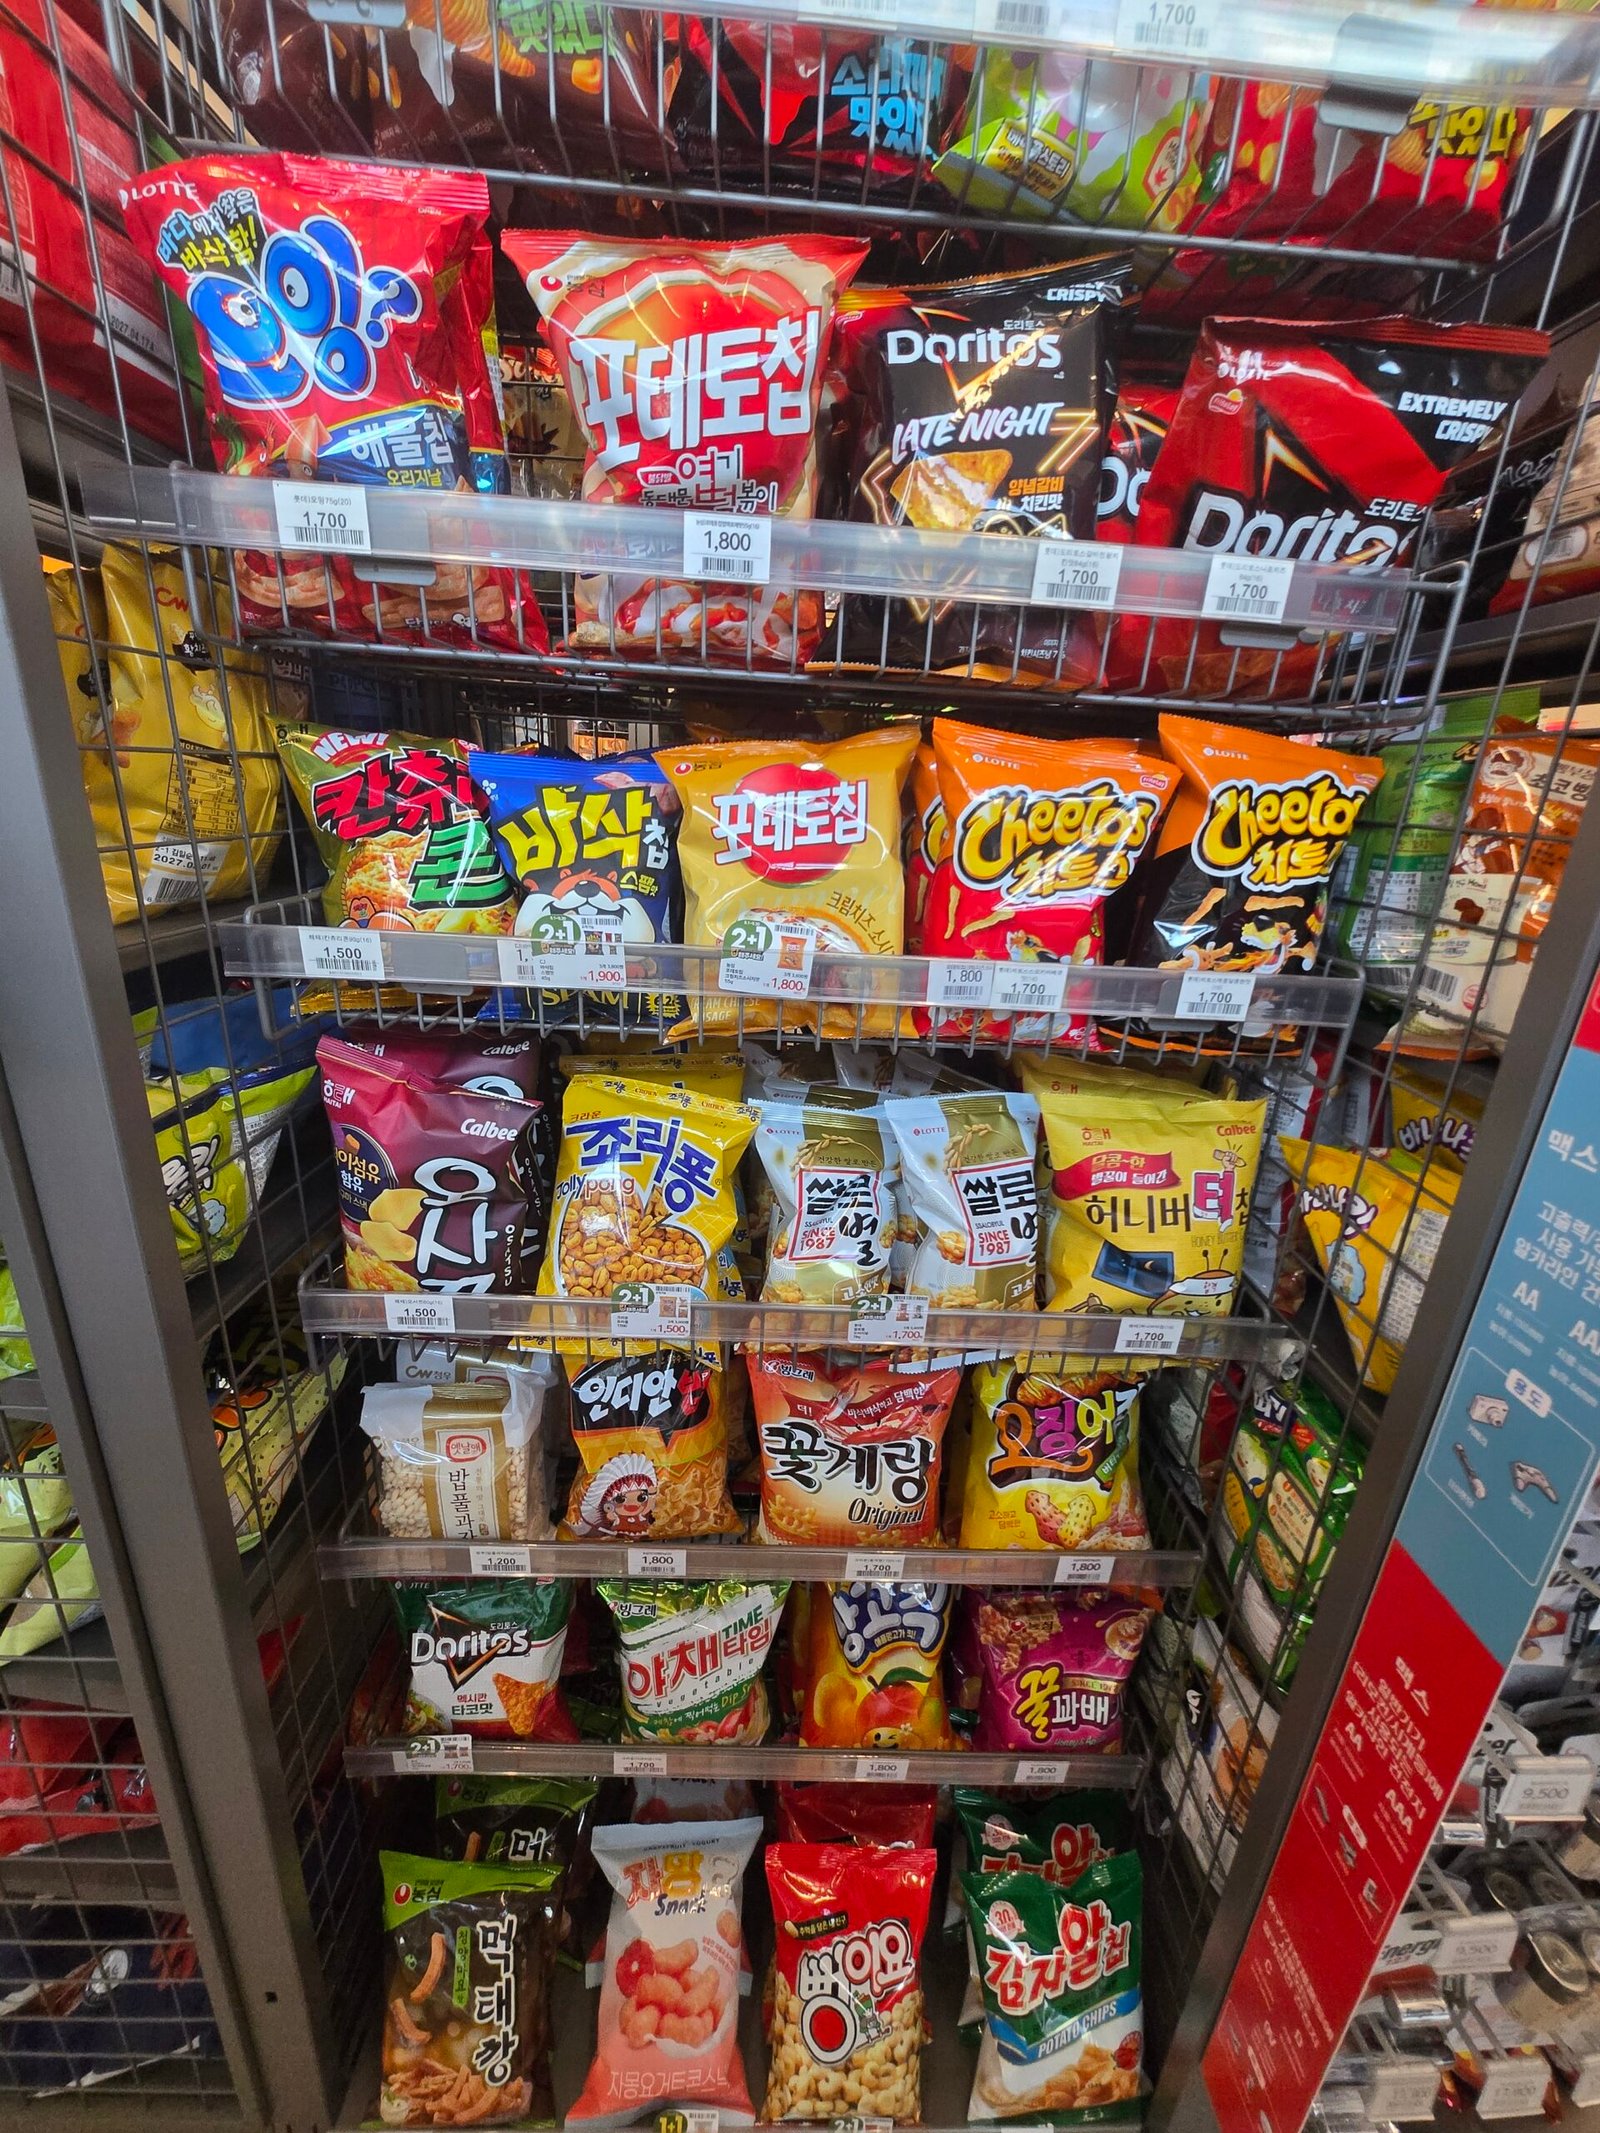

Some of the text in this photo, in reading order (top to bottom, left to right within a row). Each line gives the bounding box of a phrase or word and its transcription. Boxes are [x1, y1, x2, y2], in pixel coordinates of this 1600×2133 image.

[1149, 3, 1196, 26] 1,700
[131, 181, 198, 200] LOTTE
[181, 215, 257, 270] 바삭함!
[1046, 286, 1105, 302] CRISPY
[1003, 319, 1045, 331] 도리토스
[887, 328, 1062, 368] Doritos
[569, 306, 821, 469] 포테토칩
[1398, 392, 1507, 421] EXTREMELY
[347, 410, 455, 468] 해물칩
[891, 402, 1064, 465] LATE NIGHT
[1008, 477, 1064, 496] 양념갈비
[1020, 495, 1063, 513] 치킨맛
[303, 511, 347, 528] 1,700
[704, 530, 751, 552] 1,800
[1058, 569, 1099, 585] 1,700
[1229, 583, 1268, 600] 1,700
[314, 732, 389, 761] NEW!
[1214, 748, 1249, 761] LOTTE
[984, 756, 1020, 769] LOTTE
[711, 780, 868, 865] 포테토칩
[1203, 778, 1365, 866] Cheeto
[962, 785, 1154, 880] Cheetos
[412, 820, 509, 902] 콘
[1249, 838, 1345, 885] 치토
[620, 871, 658, 896] 스팸맛
[826, 891, 876, 932] 크림치즈
[539, 921, 574, 944] 2+1
[731, 926, 767, 951] 2+1
[323, 947, 362, 959] 1,500
[588, 970, 620, 982] 1,900
[771, 978, 803, 991] 1,800
[946, 970, 982, 983] 1,800
[1011, 983, 1045, 994] 1,700
[1198, 991, 1233, 1003] 1,700
[482, 1041, 530, 1056] Calbee
[460, 1118, 518, 1141] Calbee
[922, 1127, 945, 1135] LOTTE
[1217, 1123, 1257, 1137] Calbee
[335, 1148, 381, 1184] 이섬유
[565, 1117, 719, 1213] 죠리퐁
[340, 1169, 364, 1193] 함유
[800, 1238, 836, 1250] 1987
[978, 1230, 1009, 1243] SINCE
[1191, 1235, 1215, 1247] HONEY
[1537, 1227, 1572, 1259] 사용
[504, 1225, 516, 1287] OSATSU
[979, 1242, 1011, 1256] 1987
[619, 1287, 649, 1306] 2+1
[858, 1297, 887, 1313] 2+1
[1513, 1281, 1540, 1312] AA
[404, 1308, 437, 1318] 1,500
[657, 1325, 686, 1333] 1,500
[893, 1331, 920, 1339] 1,700
[1134, 1332, 1164, 1341] 1,700
[780, 1362, 815, 1381] 빙그레
[797, 1404, 812, 1416] 더!
[894, 1386, 925, 1404] 담백한
[763, 1421, 934, 1503] 꽃게랑
[448, 1468, 477, 1539] 밥풀과자
[848, 1498, 926, 1530] Original
[488, 1557, 517, 1566] 1,200
[642, 1555, 674, 1565] 1,800
[1070, 1563, 1101, 1571] 1,800
[620, 1604, 656, 1617] 빙그레
[490, 1621, 518, 1630] 도리토스
[722, 1605, 763, 1639] TIME
[411, 1628, 529, 1663] Doritos
[627, 1631, 720, 1697] 야채
[723, 1617, 771, 1658] 타임
[657, 1658, 754, 1707] vegetable
[457, 1692, 487, 1702] 멕시칸
[452, 1703, 493, 1716] 타코맛
[411, 1740, 435, 1754] 2+1
[411, 1886, 442, 1902] 농심
[986, 1902, 1129, 2007] 감자알칩
[473, 1913, 519, 2087] 먹태깡
[799, 1921, 915, 2064] 뻥이요
[1038, 2001, 1118, 2057] POTATO CHIPS
[660, 2115, 684, 2133] 1+1
[834, 2118, 859, 2132] 2+1
